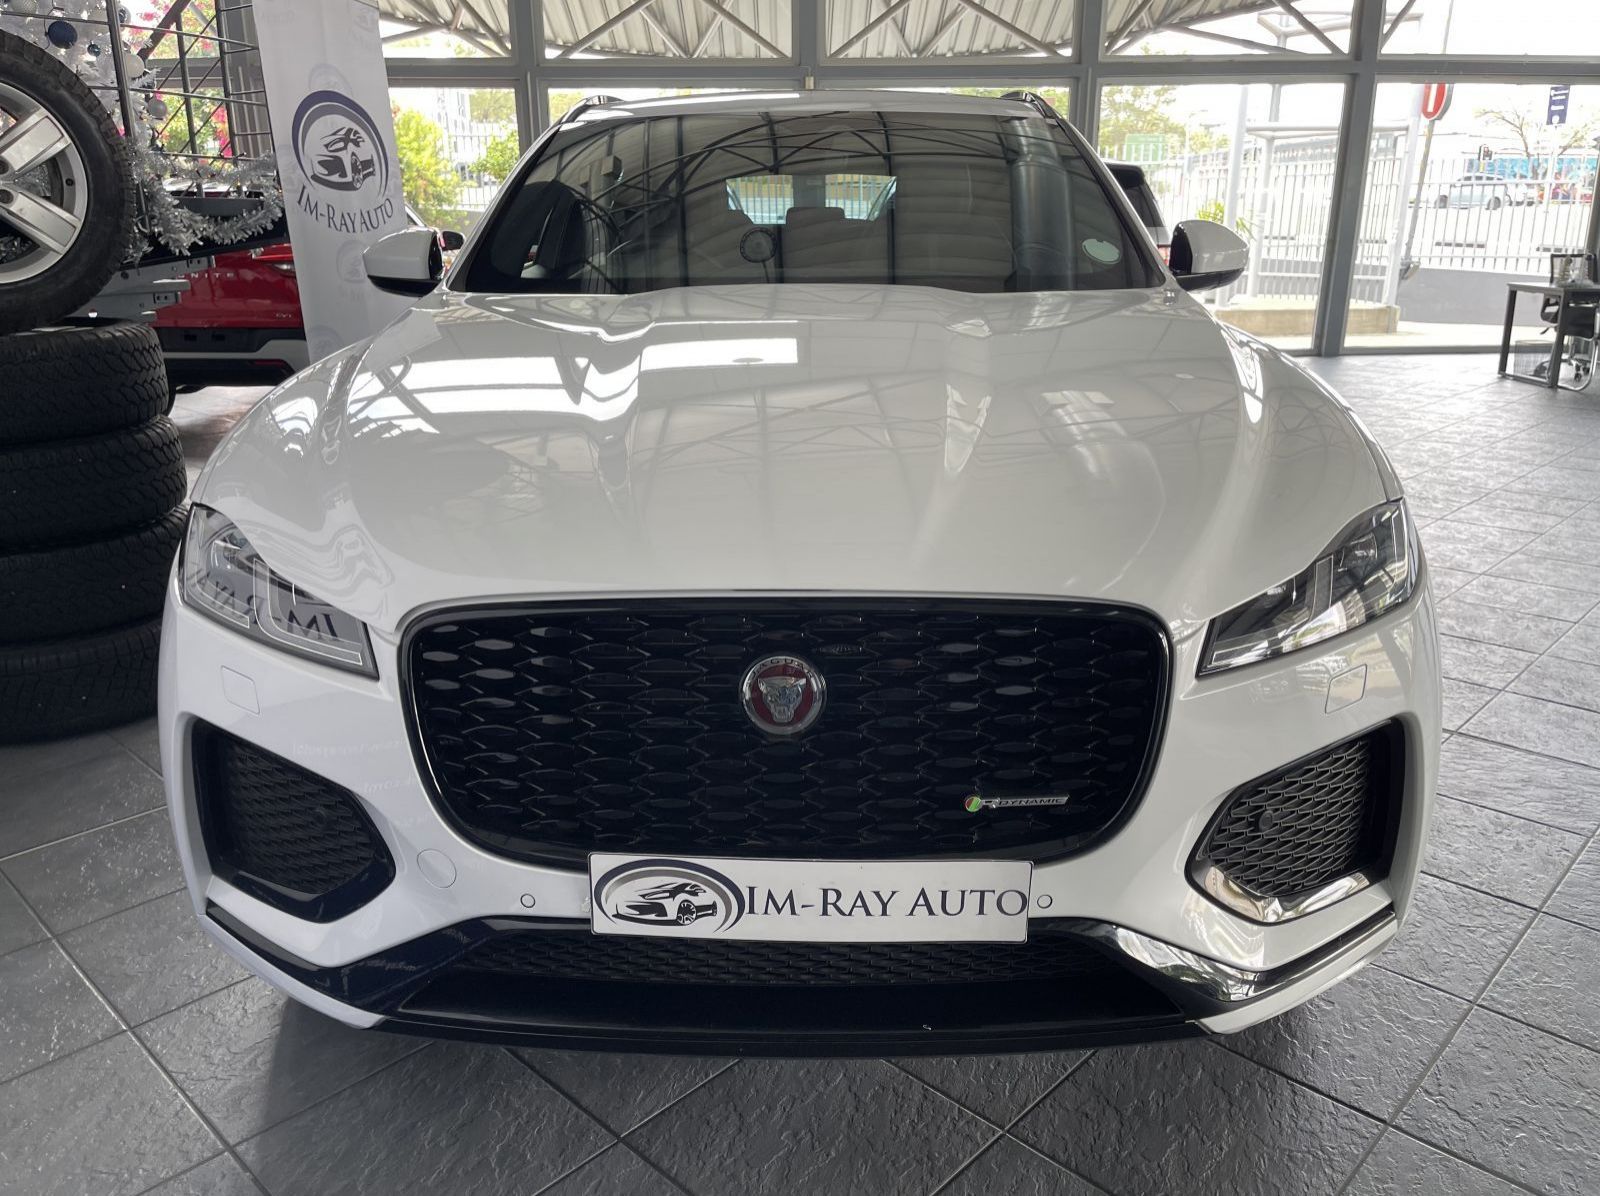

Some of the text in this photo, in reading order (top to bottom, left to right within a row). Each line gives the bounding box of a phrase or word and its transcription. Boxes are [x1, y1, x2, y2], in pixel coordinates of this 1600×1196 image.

[297, 184, 394, 233] IM-RAY AUTO
[746, 886, 1028, 916] IM-RAY AUTO
